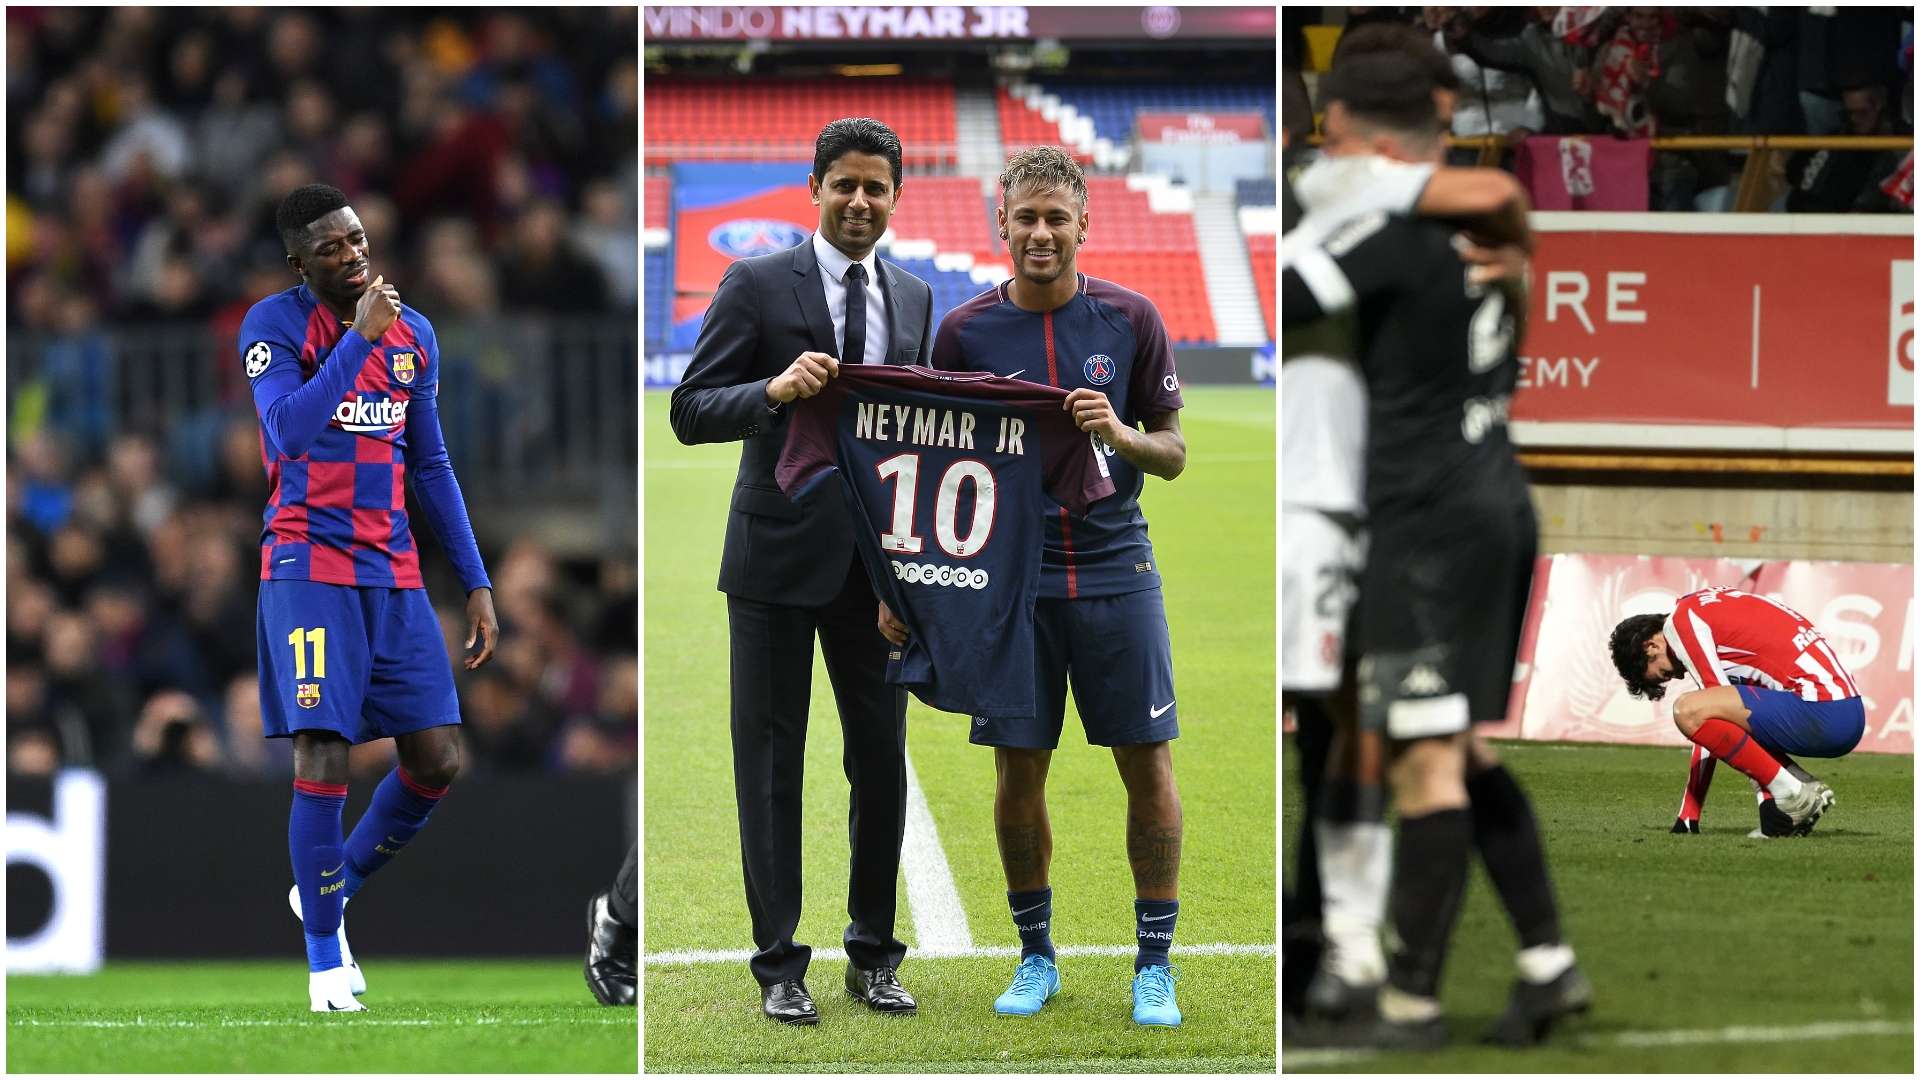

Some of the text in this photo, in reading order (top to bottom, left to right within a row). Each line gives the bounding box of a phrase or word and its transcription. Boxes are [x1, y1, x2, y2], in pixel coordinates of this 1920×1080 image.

[782, 6, 965, 38] NEYMAR
[971, 6, 1029, 38] JR
[1546, 271, 1648, 335] RE
[856, 402, 1025, 455] NEYMAR JR
[875, 452, 998, 559] 10
[288, 627, 326, 679] 11
[1017, 921, 1047, 932] PARIS
[1139, 930, 1173, 940] PARIS
